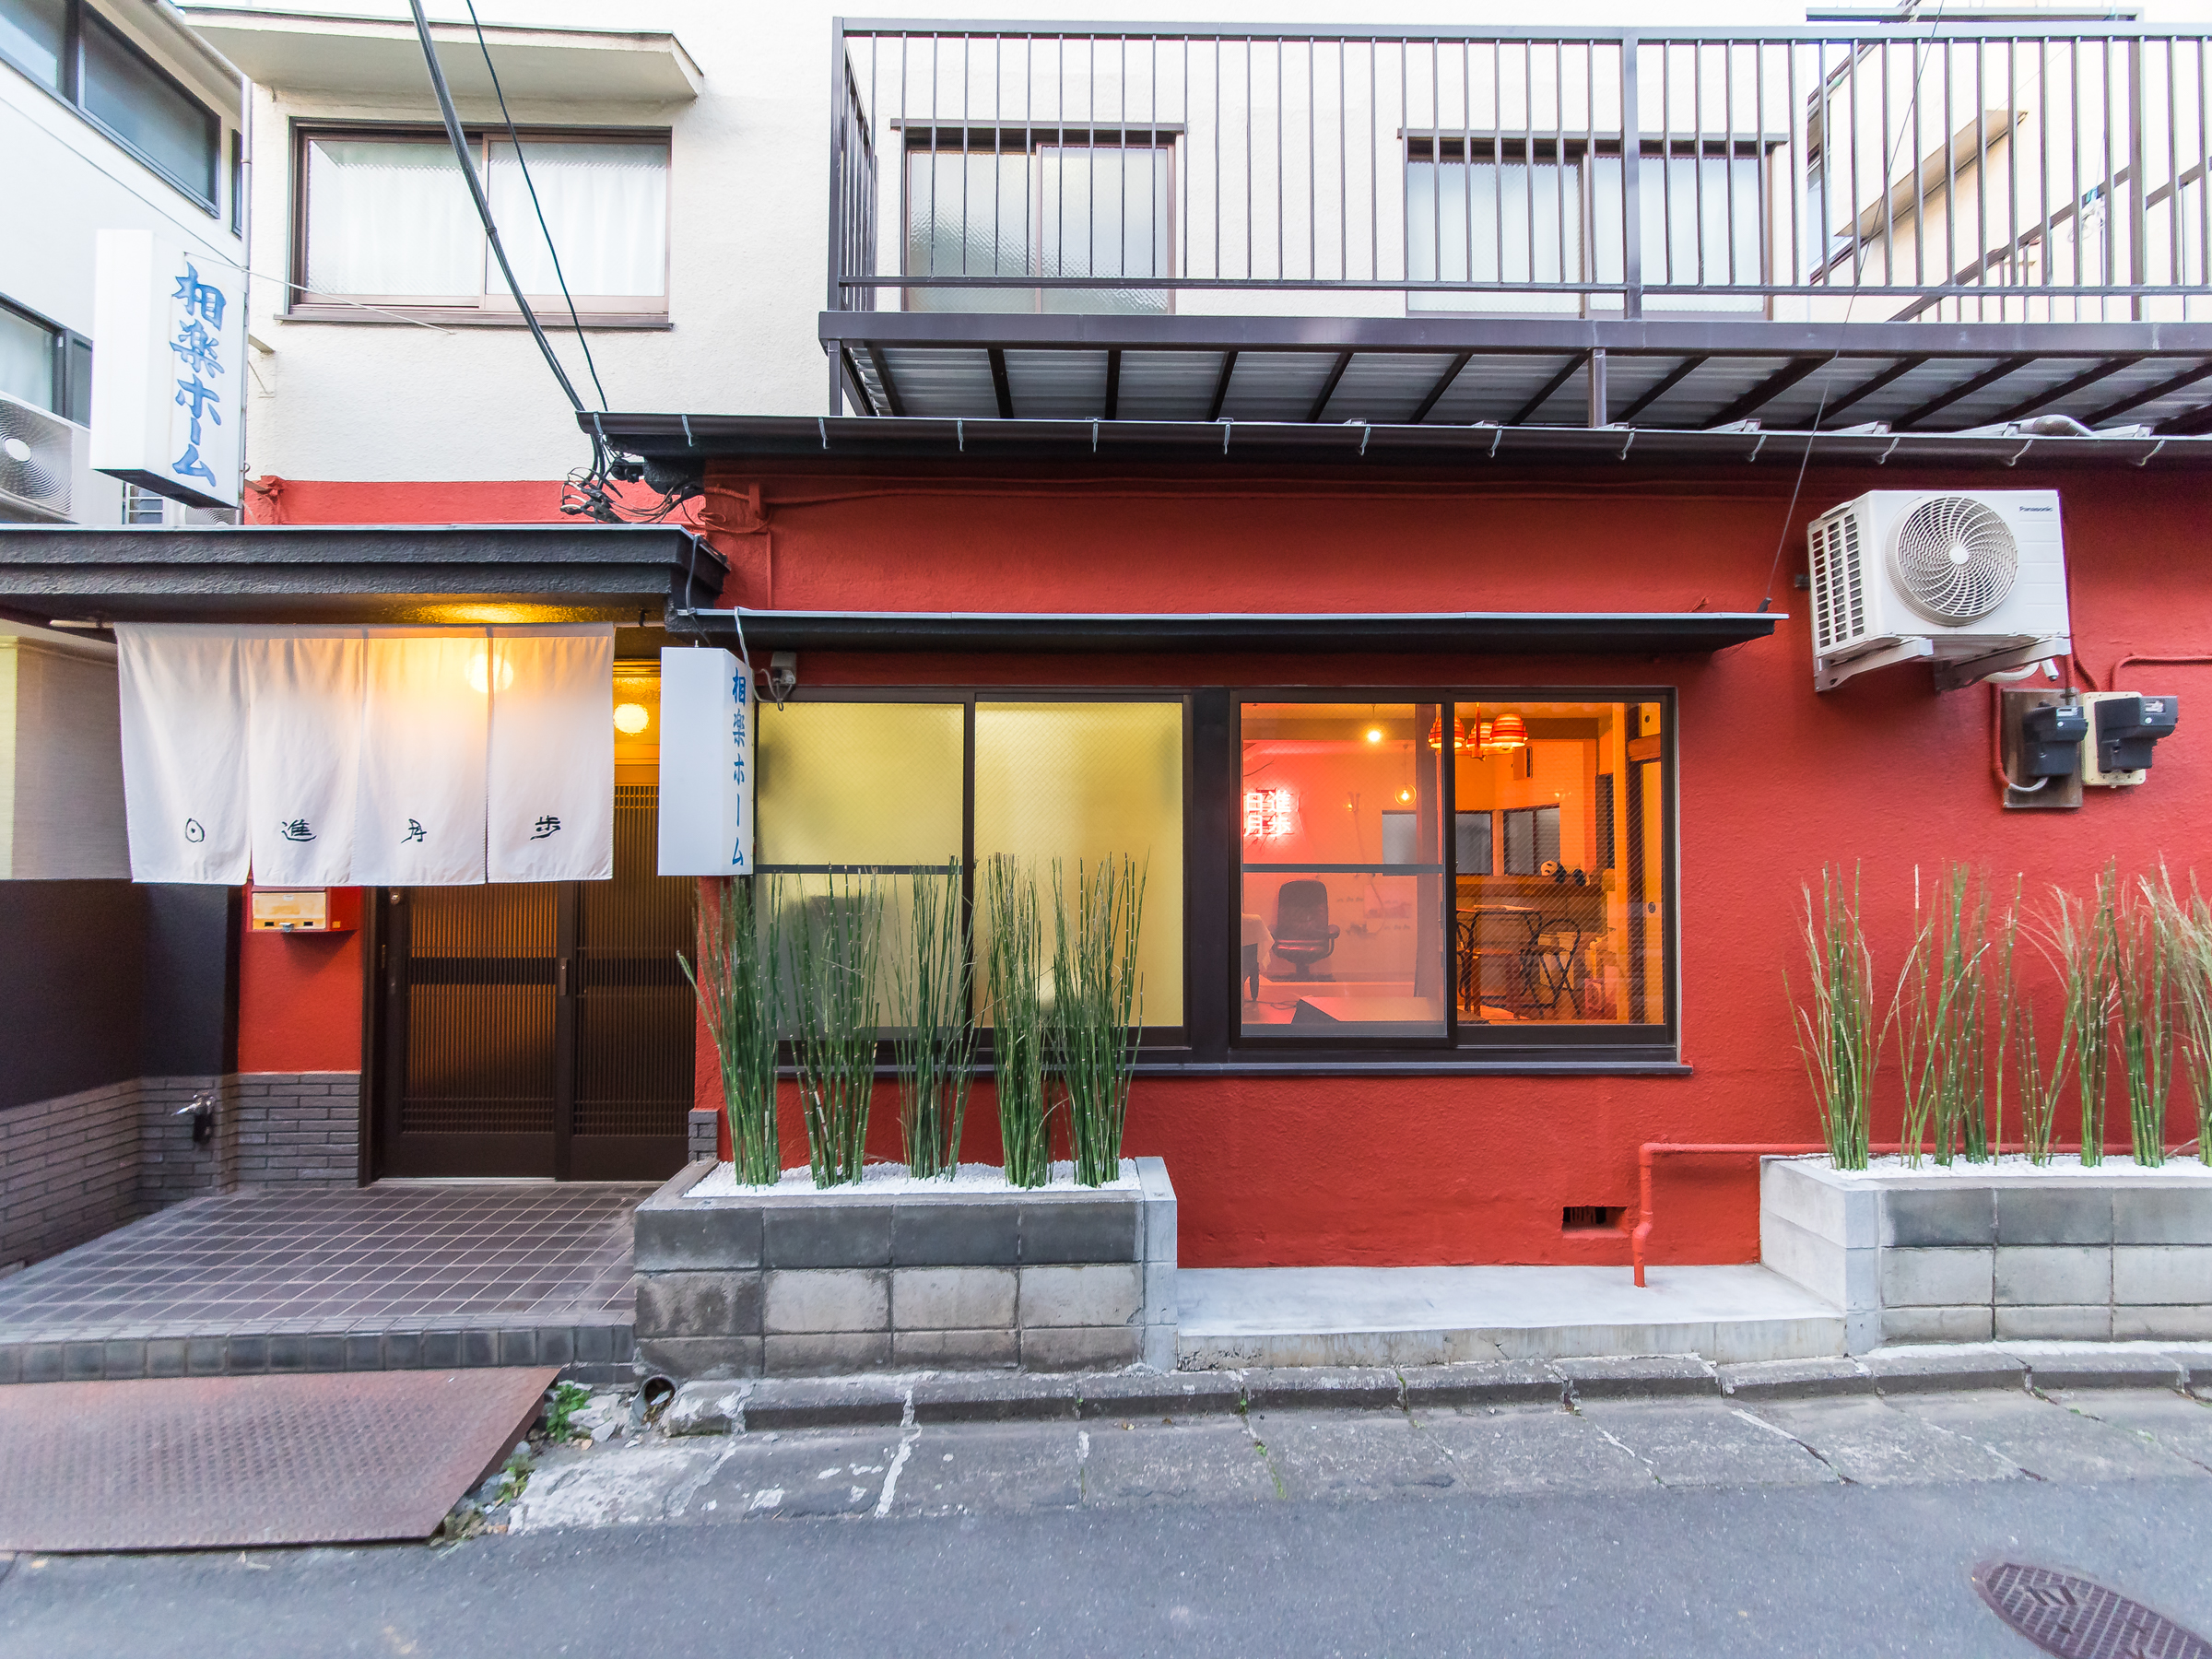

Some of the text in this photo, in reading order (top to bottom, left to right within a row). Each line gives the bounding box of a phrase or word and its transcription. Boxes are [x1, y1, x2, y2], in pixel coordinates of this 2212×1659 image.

[170, 261, 226, 487] 相楽ホーム
[732, 667, 747, 866] 相楽ホーム
[1247, 790, 1291, 813] 日進
[1243, 814, 1291, 837] 月歩
